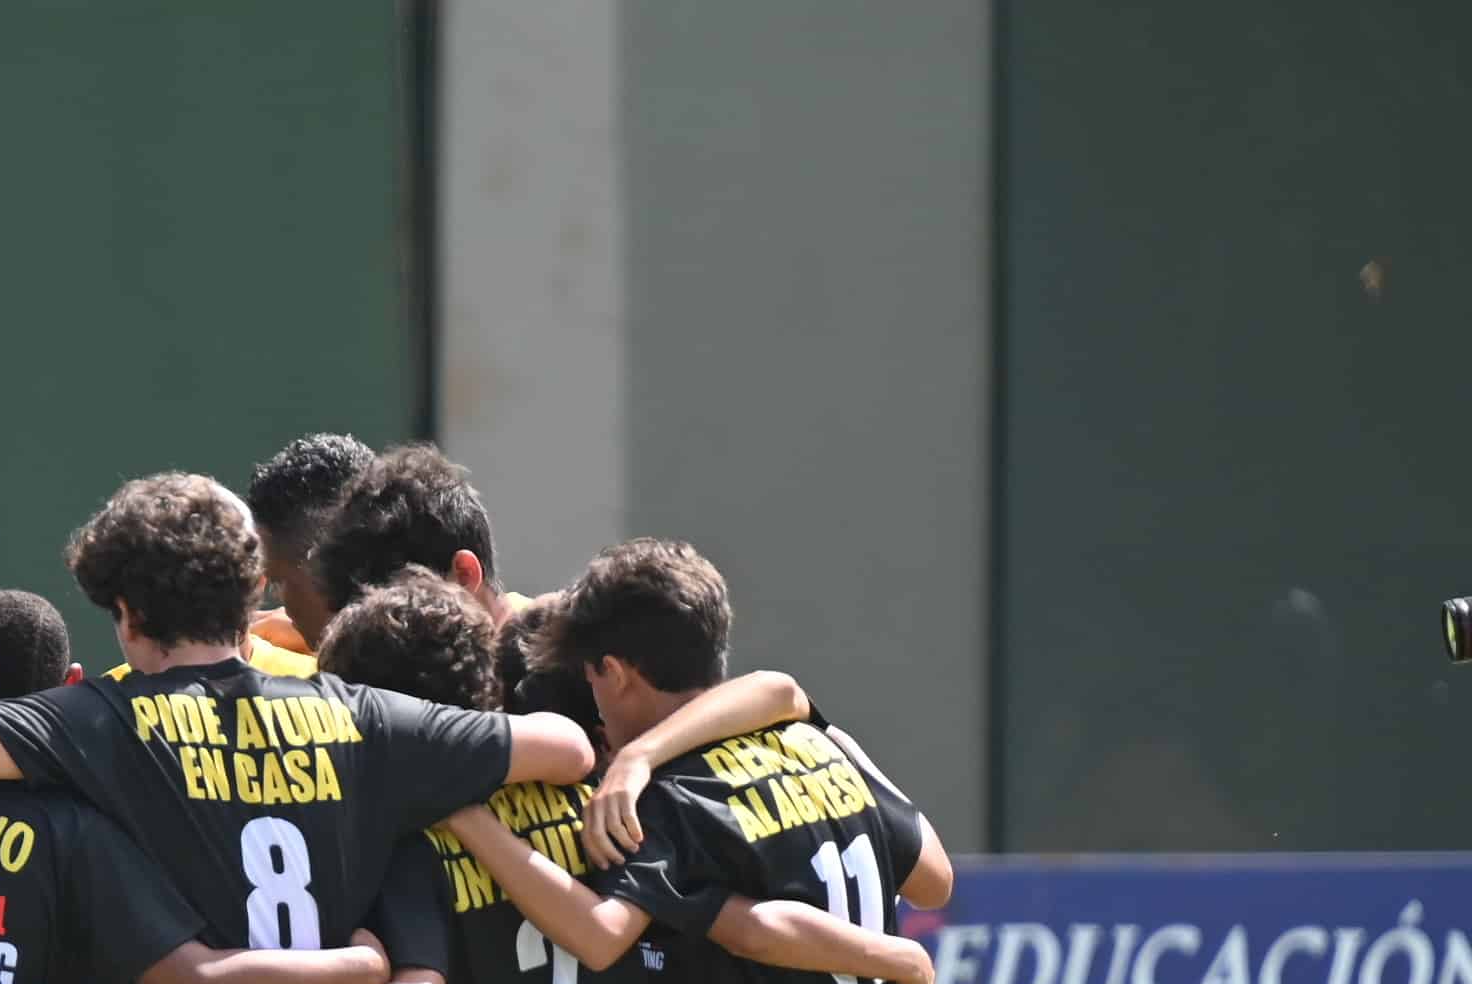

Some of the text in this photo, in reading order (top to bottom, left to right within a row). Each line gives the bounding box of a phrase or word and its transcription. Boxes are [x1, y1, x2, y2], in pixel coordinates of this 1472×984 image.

[131, 693, 363, 749] PIDE AYUDA
[179, 745, 343, 805] EN CASA
[728, 787, 781, 843] AL
[240, 816, 321, 950] 8
